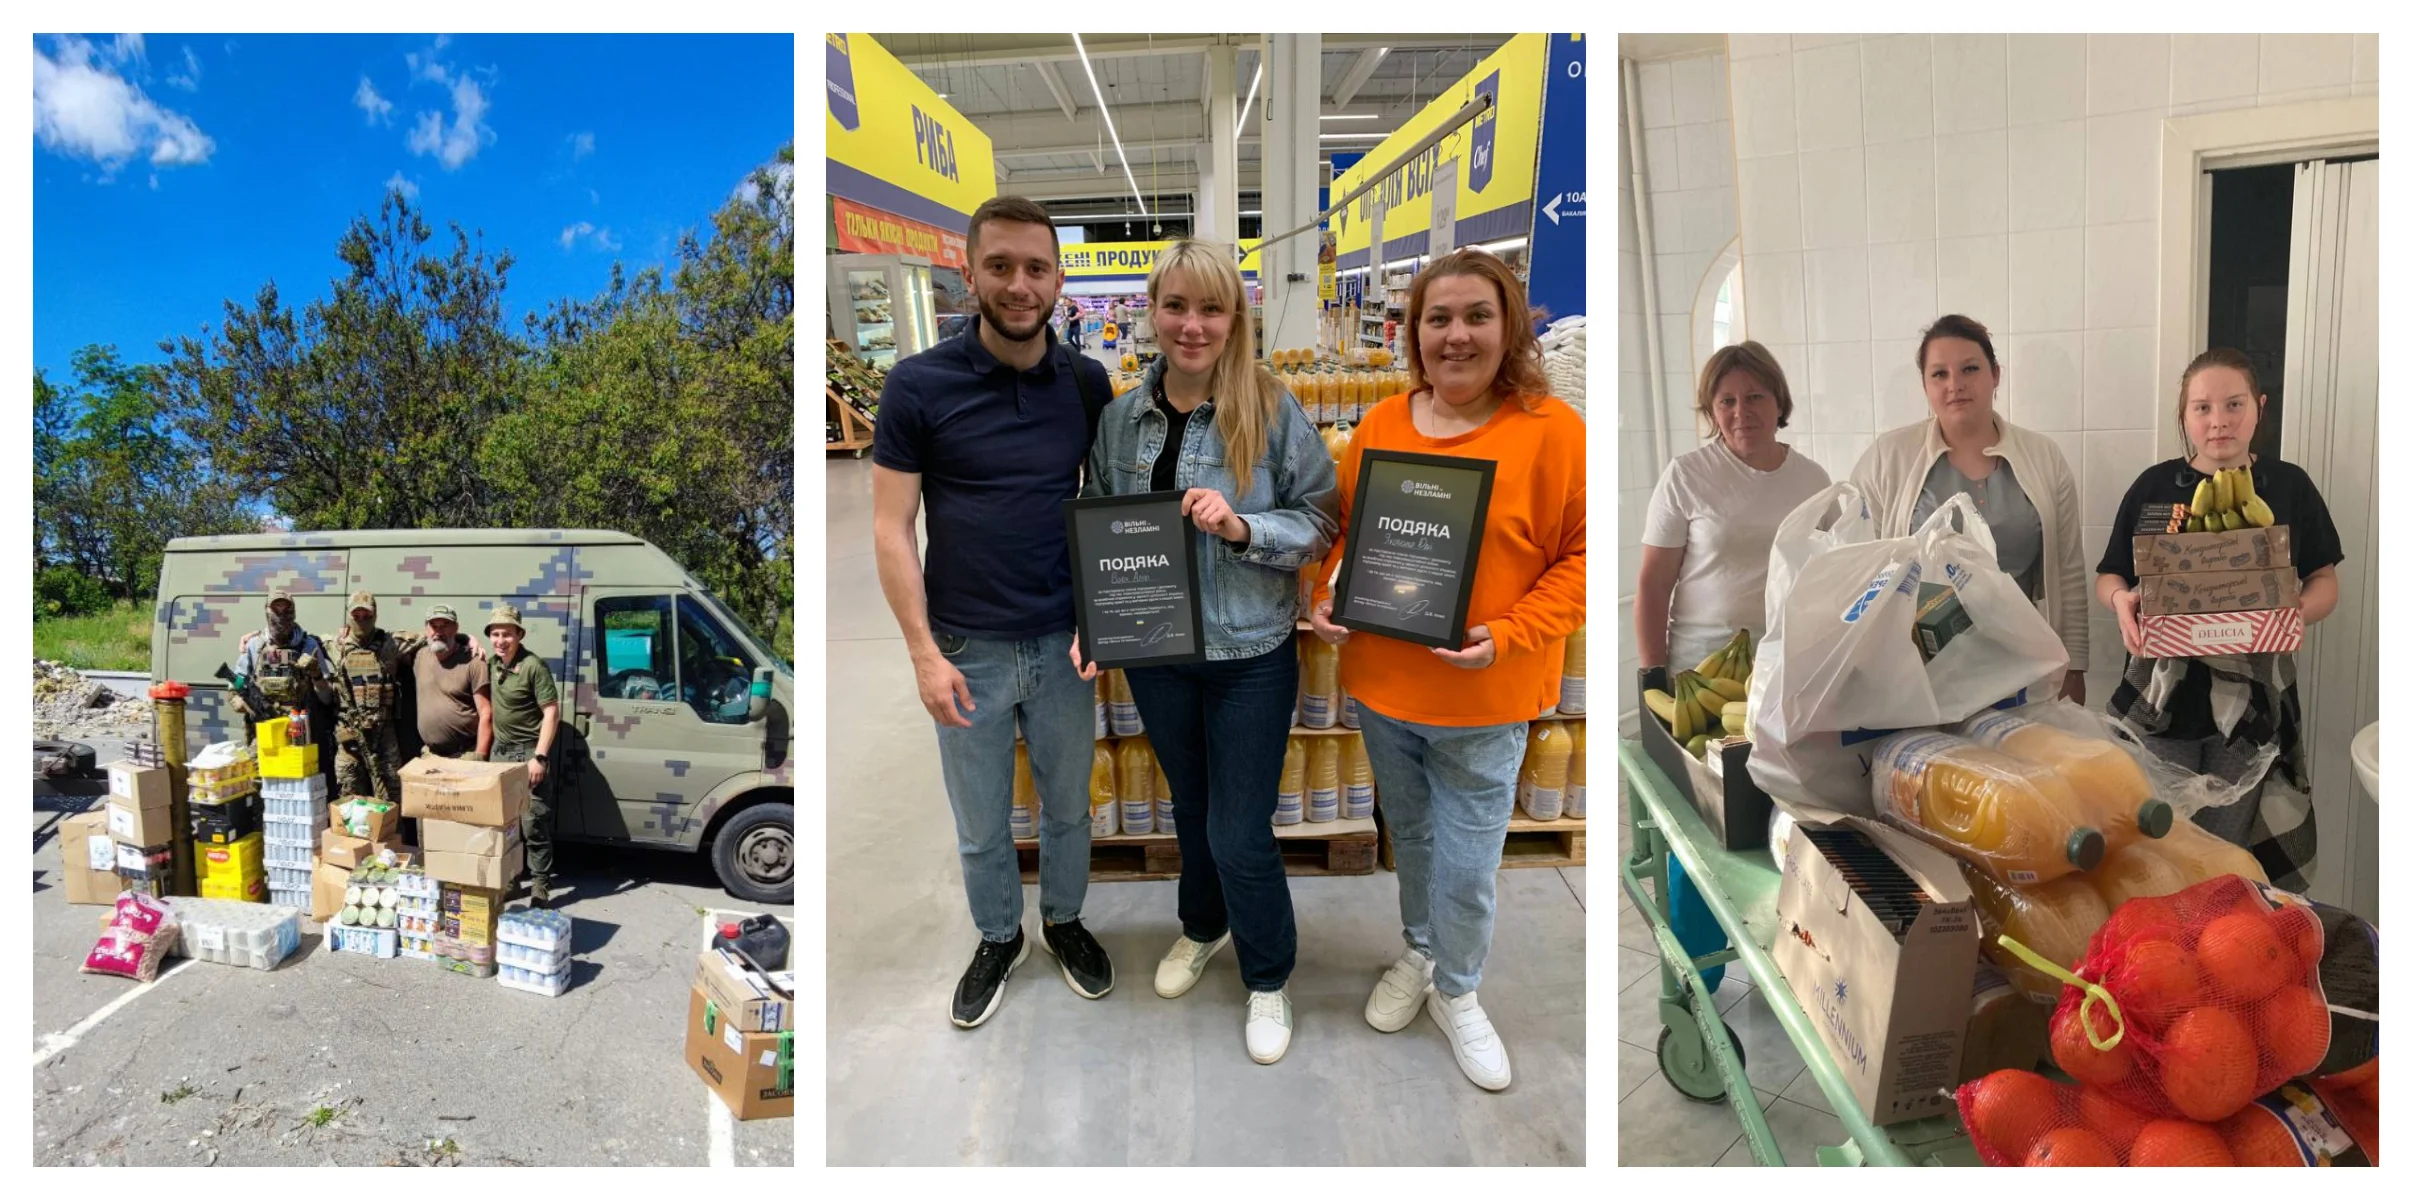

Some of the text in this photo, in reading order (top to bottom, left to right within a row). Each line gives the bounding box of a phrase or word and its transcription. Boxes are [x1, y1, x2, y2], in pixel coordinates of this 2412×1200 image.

[911, 103, 959, 184] РИБА
[1474, 140, 1491, 171] Chef
[845, 211, 879, 240] ТІЛЬКИ
[1414, 489, 1451, 499] НЕЗЛАМНІ
[1415, 482, 1440, 491] ВІЛЬНІ
[1124, 525, 1160, 534] НЕЗЛАМНІ
[1378, 516, 1451, 539] ПОДЯКА
[1099, 554, 1170, 571] ПОДЯКА
[2198, 627, 2246, 639] DELICIA
[1812, 978, 1868, 1076] MILLENNIUM
